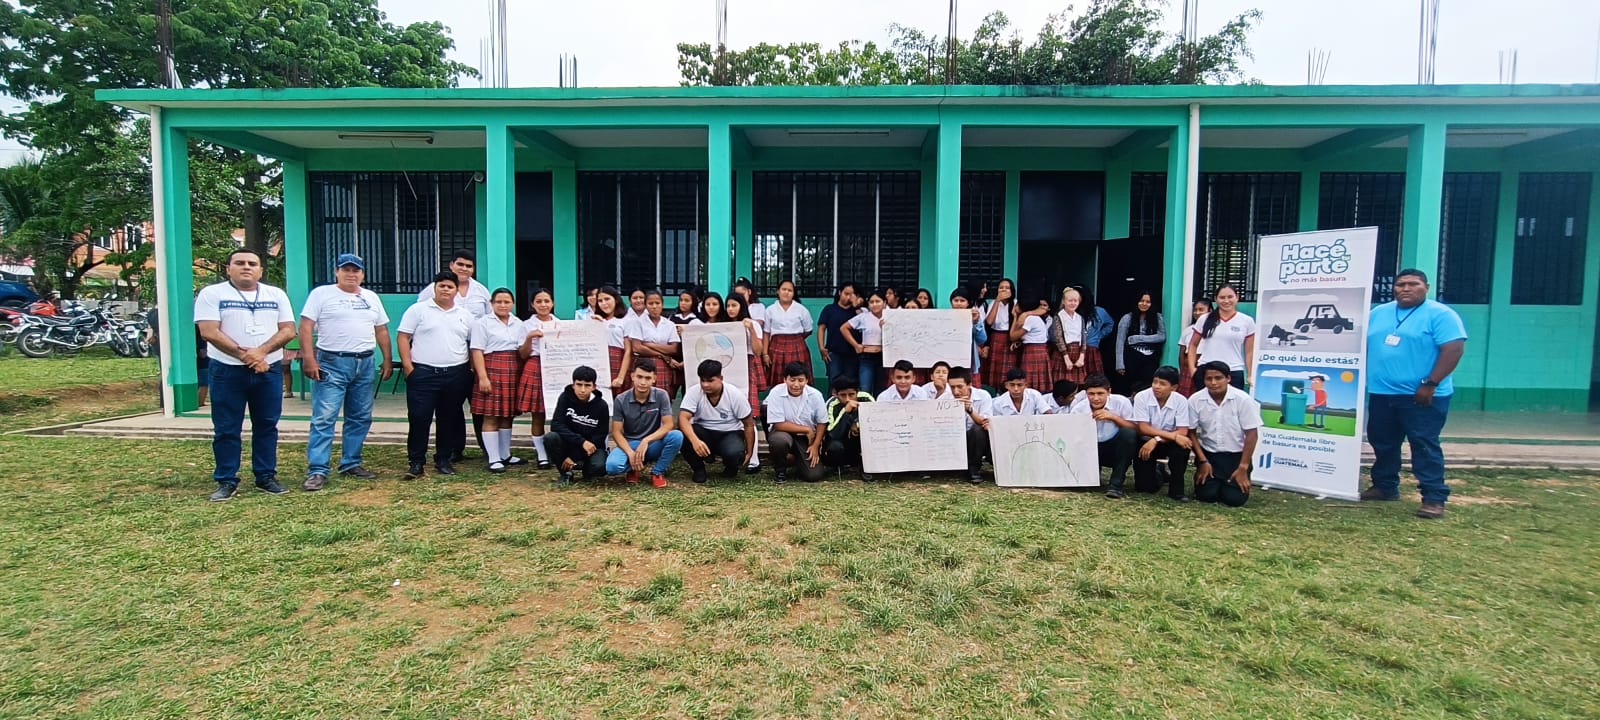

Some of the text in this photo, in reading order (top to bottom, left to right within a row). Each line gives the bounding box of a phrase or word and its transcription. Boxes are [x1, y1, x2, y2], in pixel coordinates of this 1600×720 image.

[1281, 239, 1346, 261] Hacé
[1279, 258, 1348, 280] parte
[1259, 354, 1360, 365] ¿De qué lado estás?
[1278, 434, 1317, 444] Guatemala
[1272, 440, 1297, 448] basura
[1308, 445, 1336, 454] posible
[1273, 459, 1308, 468] GUATEMALA
